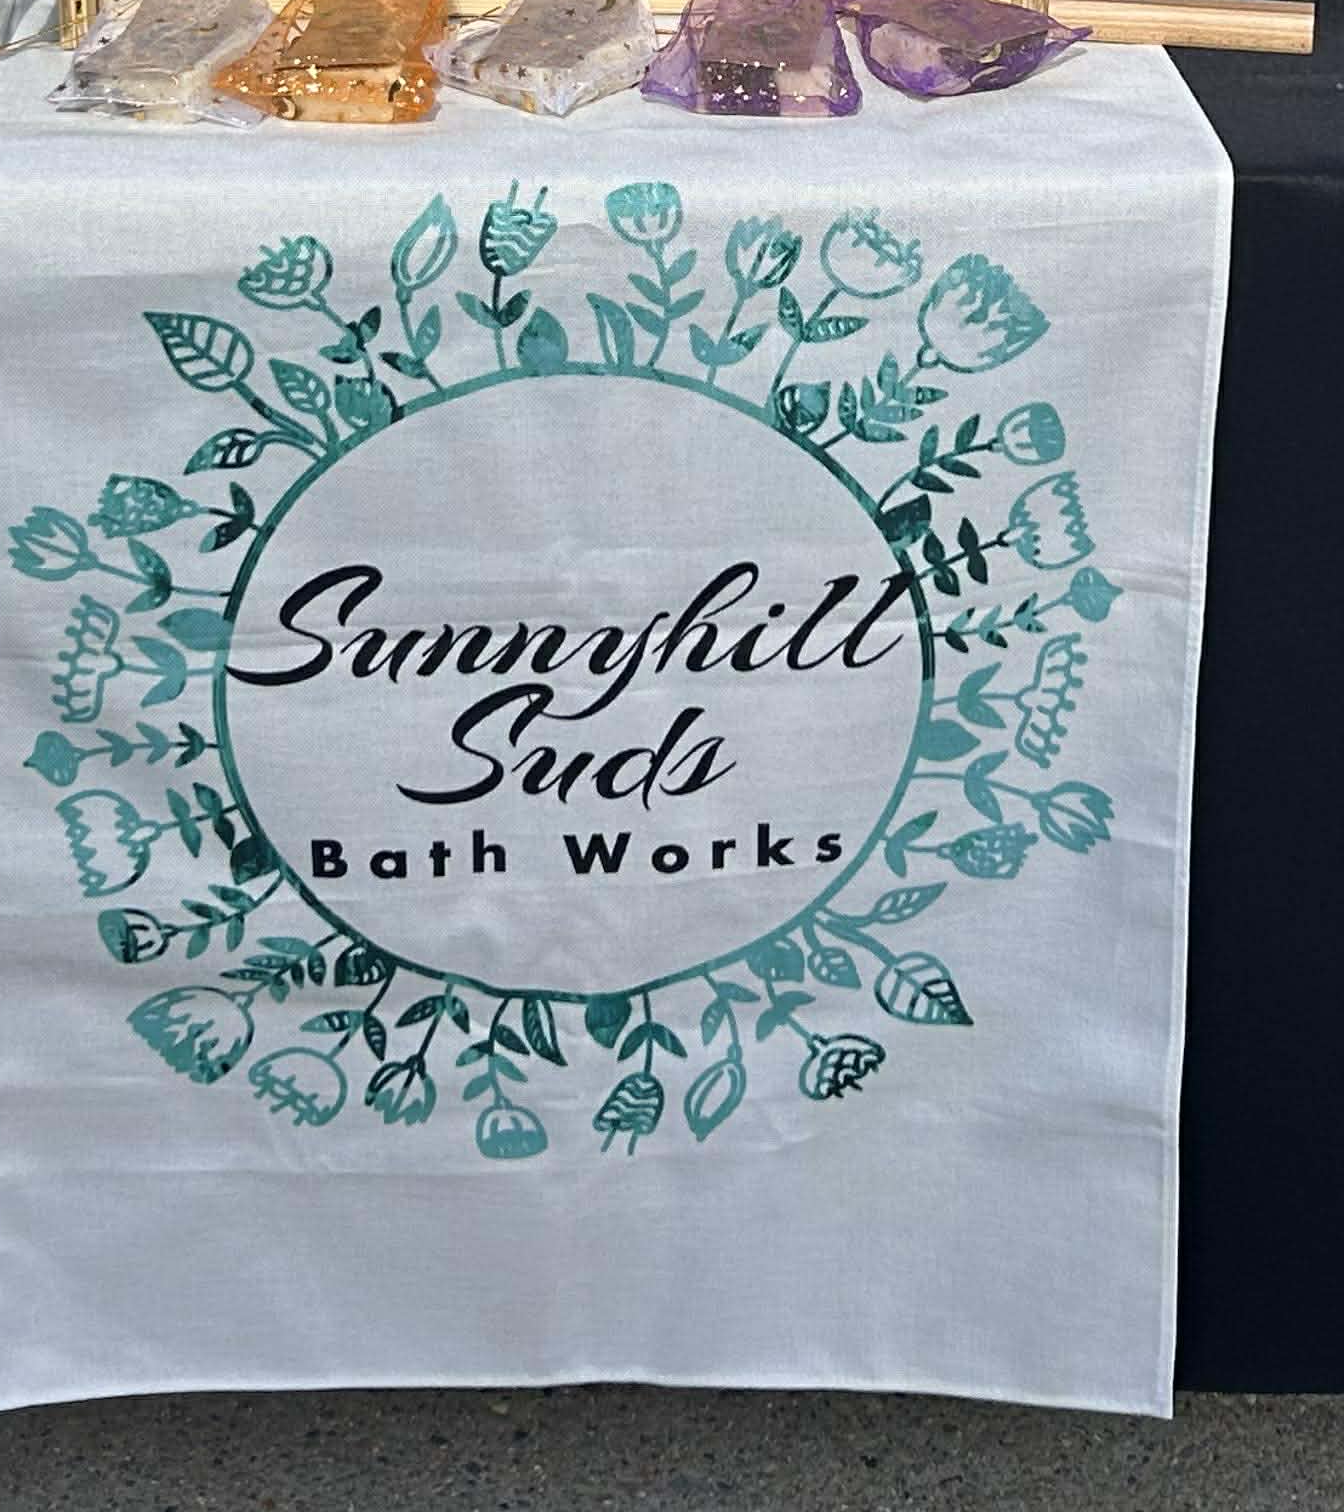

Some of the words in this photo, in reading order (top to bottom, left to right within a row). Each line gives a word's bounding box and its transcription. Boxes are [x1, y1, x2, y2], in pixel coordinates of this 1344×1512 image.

[224, 561, 915, 721] Sunnyhill
[396, 682, 738, 811] Suds
[310, 829, 509, 880] Bath
[563, 822, 843, 875] Works
